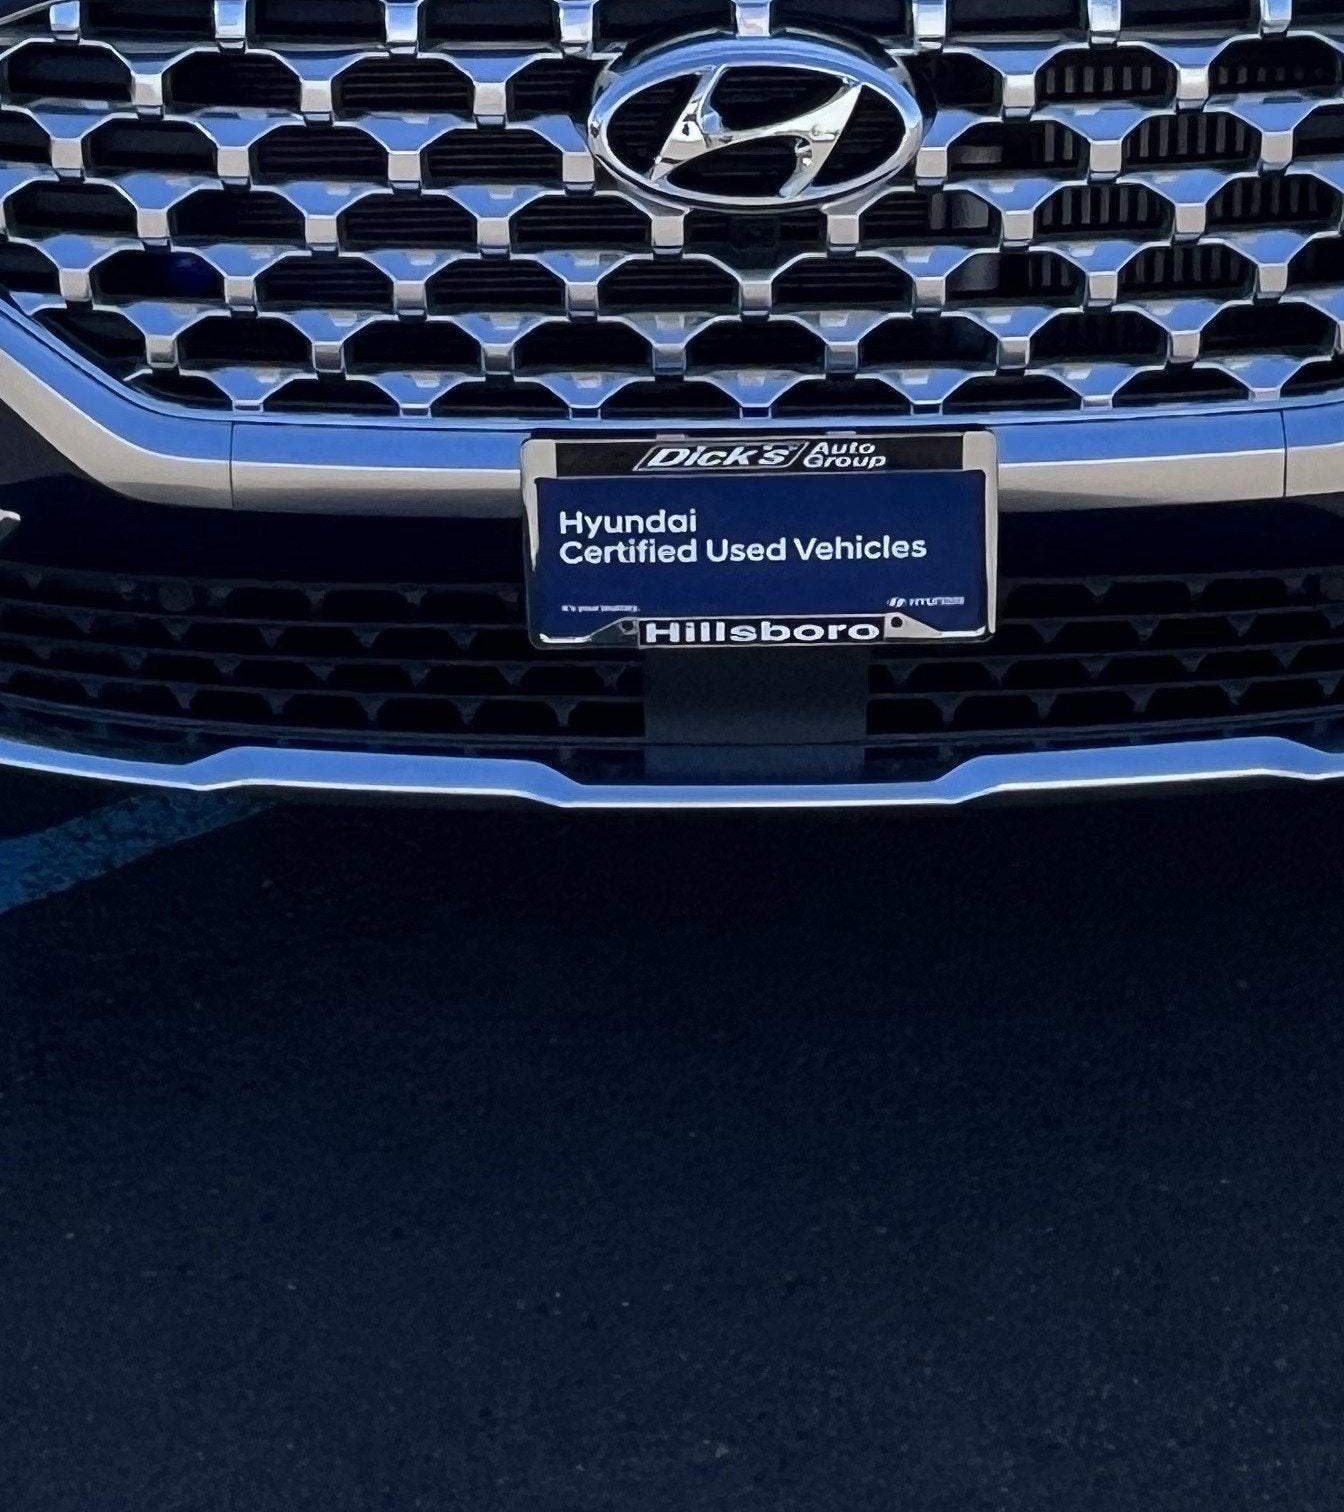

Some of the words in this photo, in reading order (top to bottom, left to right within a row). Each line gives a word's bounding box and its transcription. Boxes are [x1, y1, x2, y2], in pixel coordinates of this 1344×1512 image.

[647, 444, 792, 468] Dick's
[810, 441, 875, 455] Auto
[803, 454, 886, 469] Group
[559, 509, 697, 539] Hyundai
[559, 538, 698, 565] Certified
[705, 538, 787, 563] Used
[793, 535, 928, 561] Vehicles
[646, 622, 881, 643] Hillsboro
